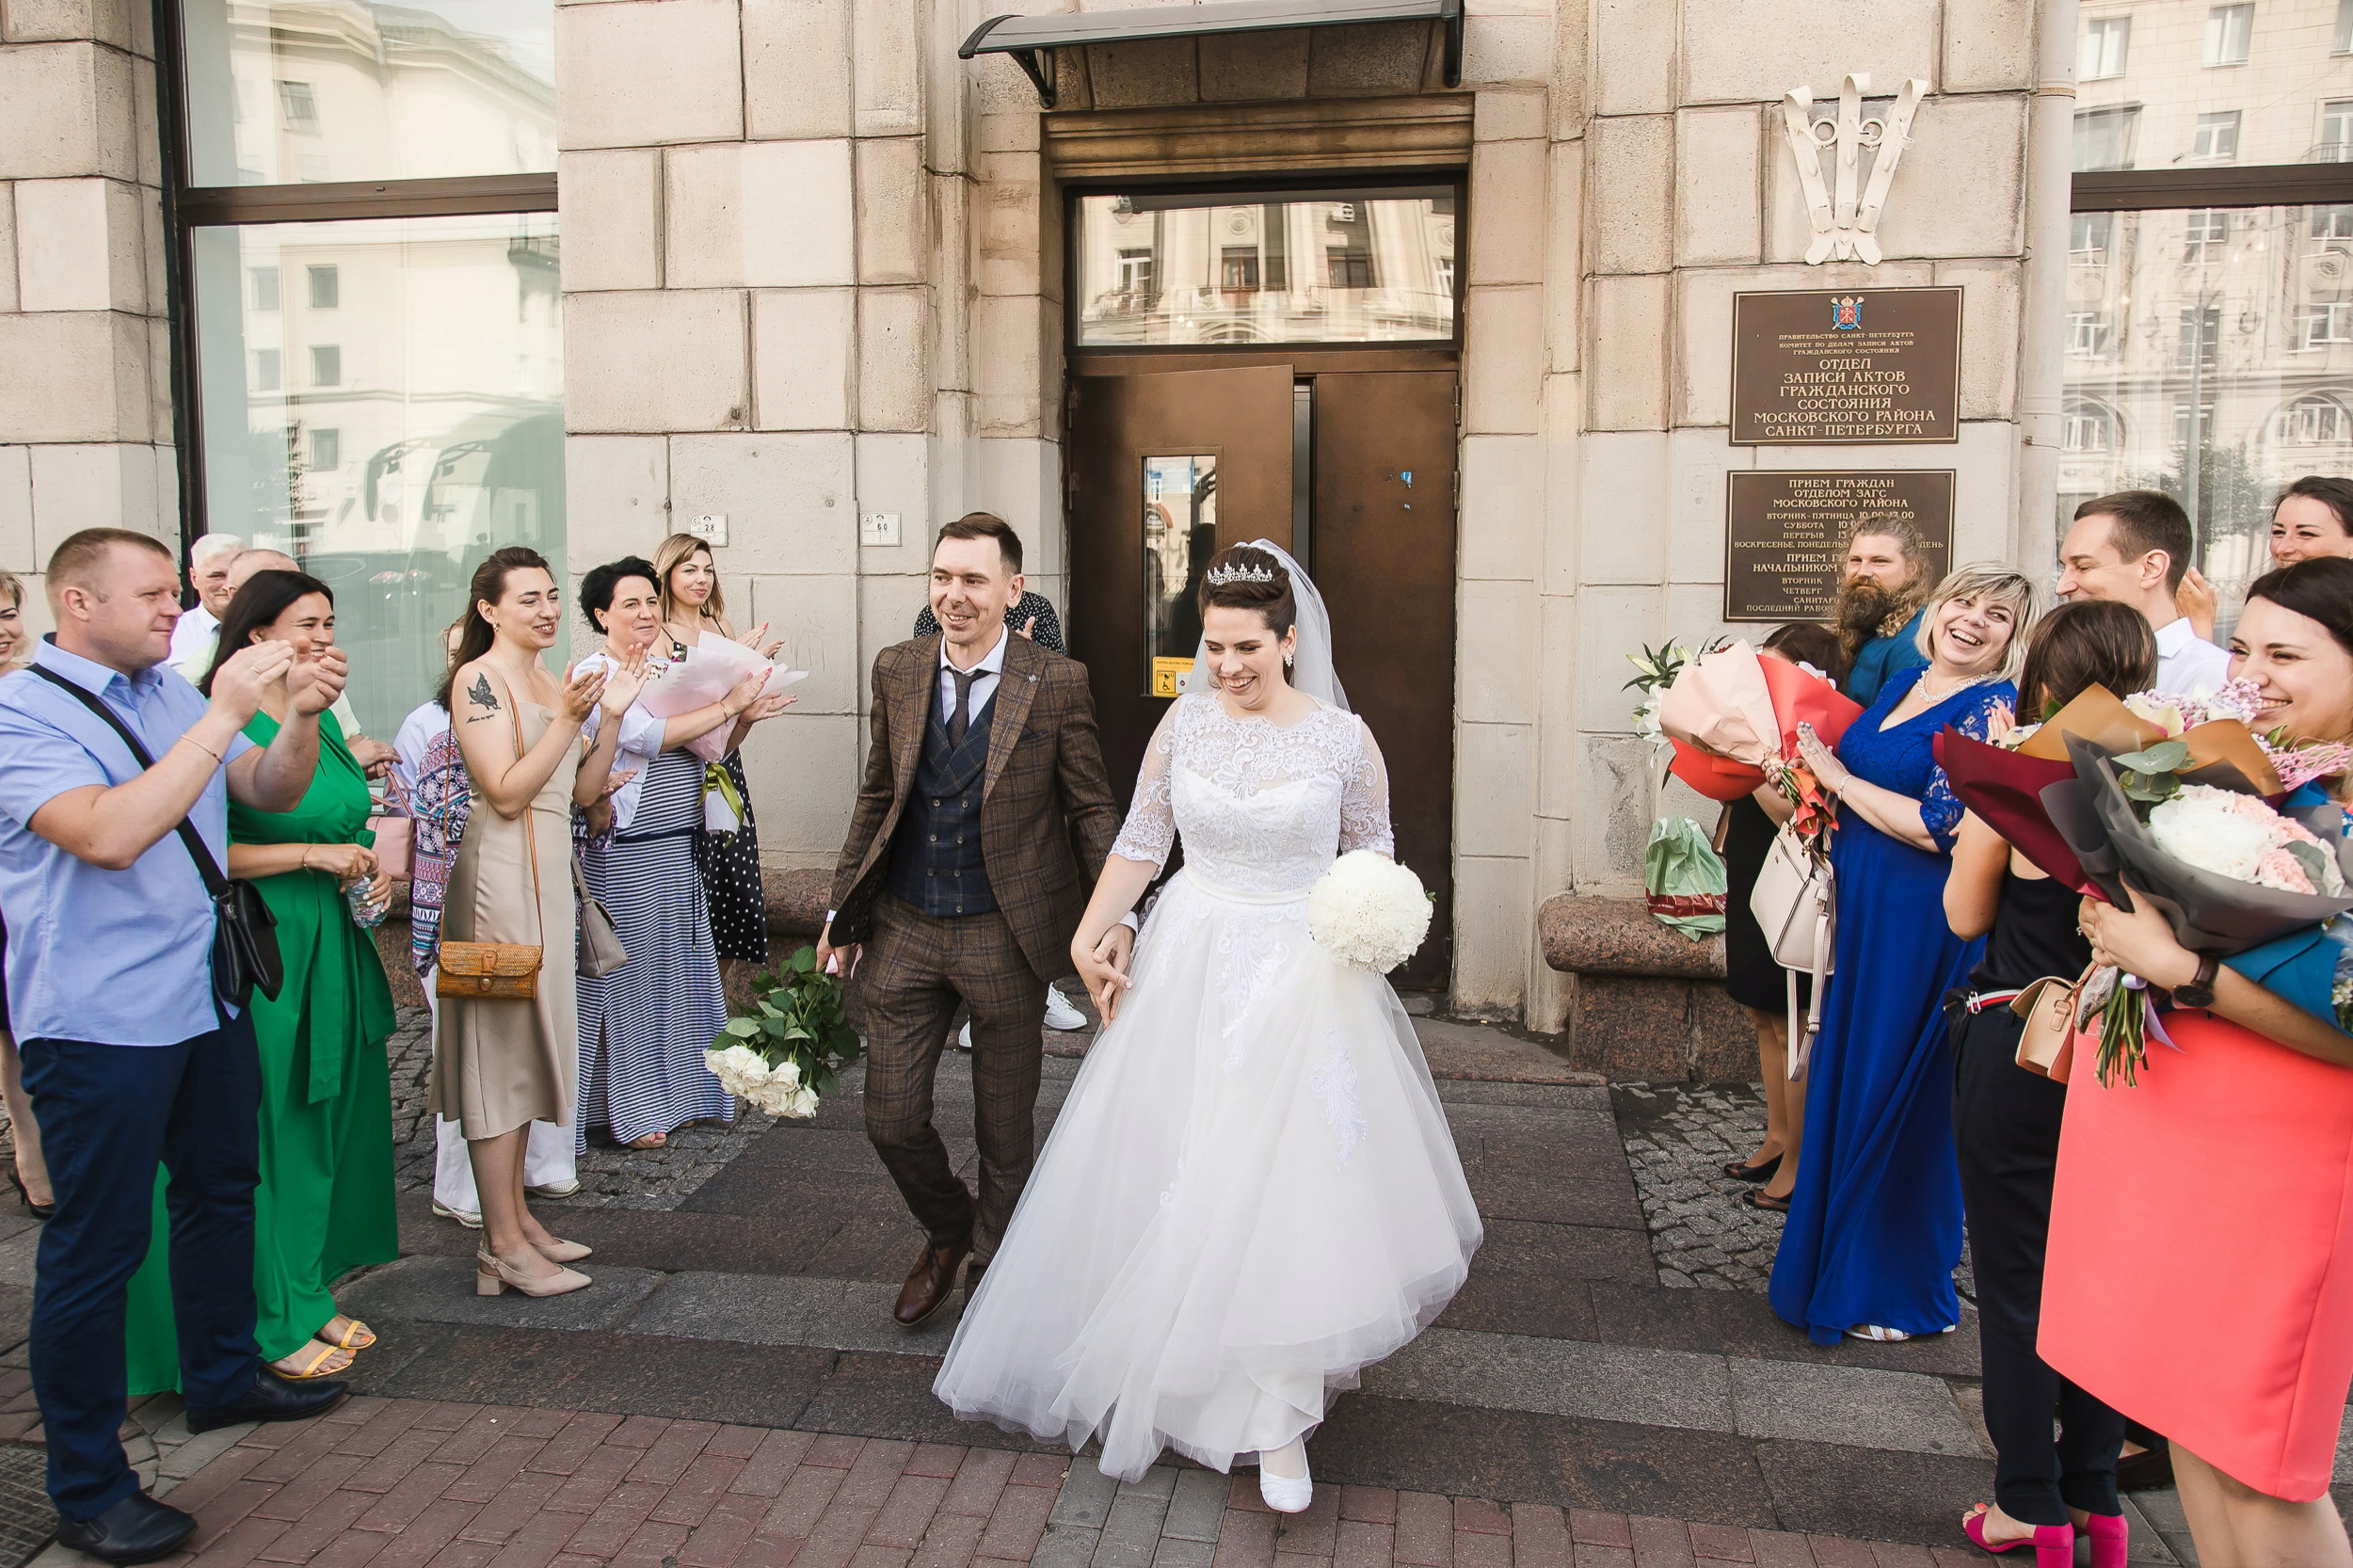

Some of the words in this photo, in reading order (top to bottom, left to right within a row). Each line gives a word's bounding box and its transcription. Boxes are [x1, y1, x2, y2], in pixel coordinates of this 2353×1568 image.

[1818, 359, 1871, 371] ОТДЕЛ
[1784, 372, 1846, 384] ЗАПИСИ
[1852, 371, 1906, 382] АКТОВ
[1780, 384, 1910, 398] ГРАЖДАНСКОГО
[1797, 398, 1892, 410] СОСТОЯНИЯ
[1753, 412, 1870, 424] МОСКОВСКОГО
[1876, 408, 1936, 422] РАЙОНА
[1765, 424, 1923, 437] САНКТ-ПЕТЕРБУРГА
[1788, 479, 1831, 488] ПРИЕМ
[1835, 479, 1895, 489] ГРАЖДАН
[1794, 489, 1850, 499] ОТДЕЛОМ
[1856, 489, 1887, 498] ЗАГС
[1772, 499, 1858, 508] МОСКОВСКОГО
[1863, 498, 1909, 507] РАЙОНА
[1786, 553, 1826, 562] ПРИЕМ
[1753, 564, 1837, 572] НАЧАЛЬНИКОМ
